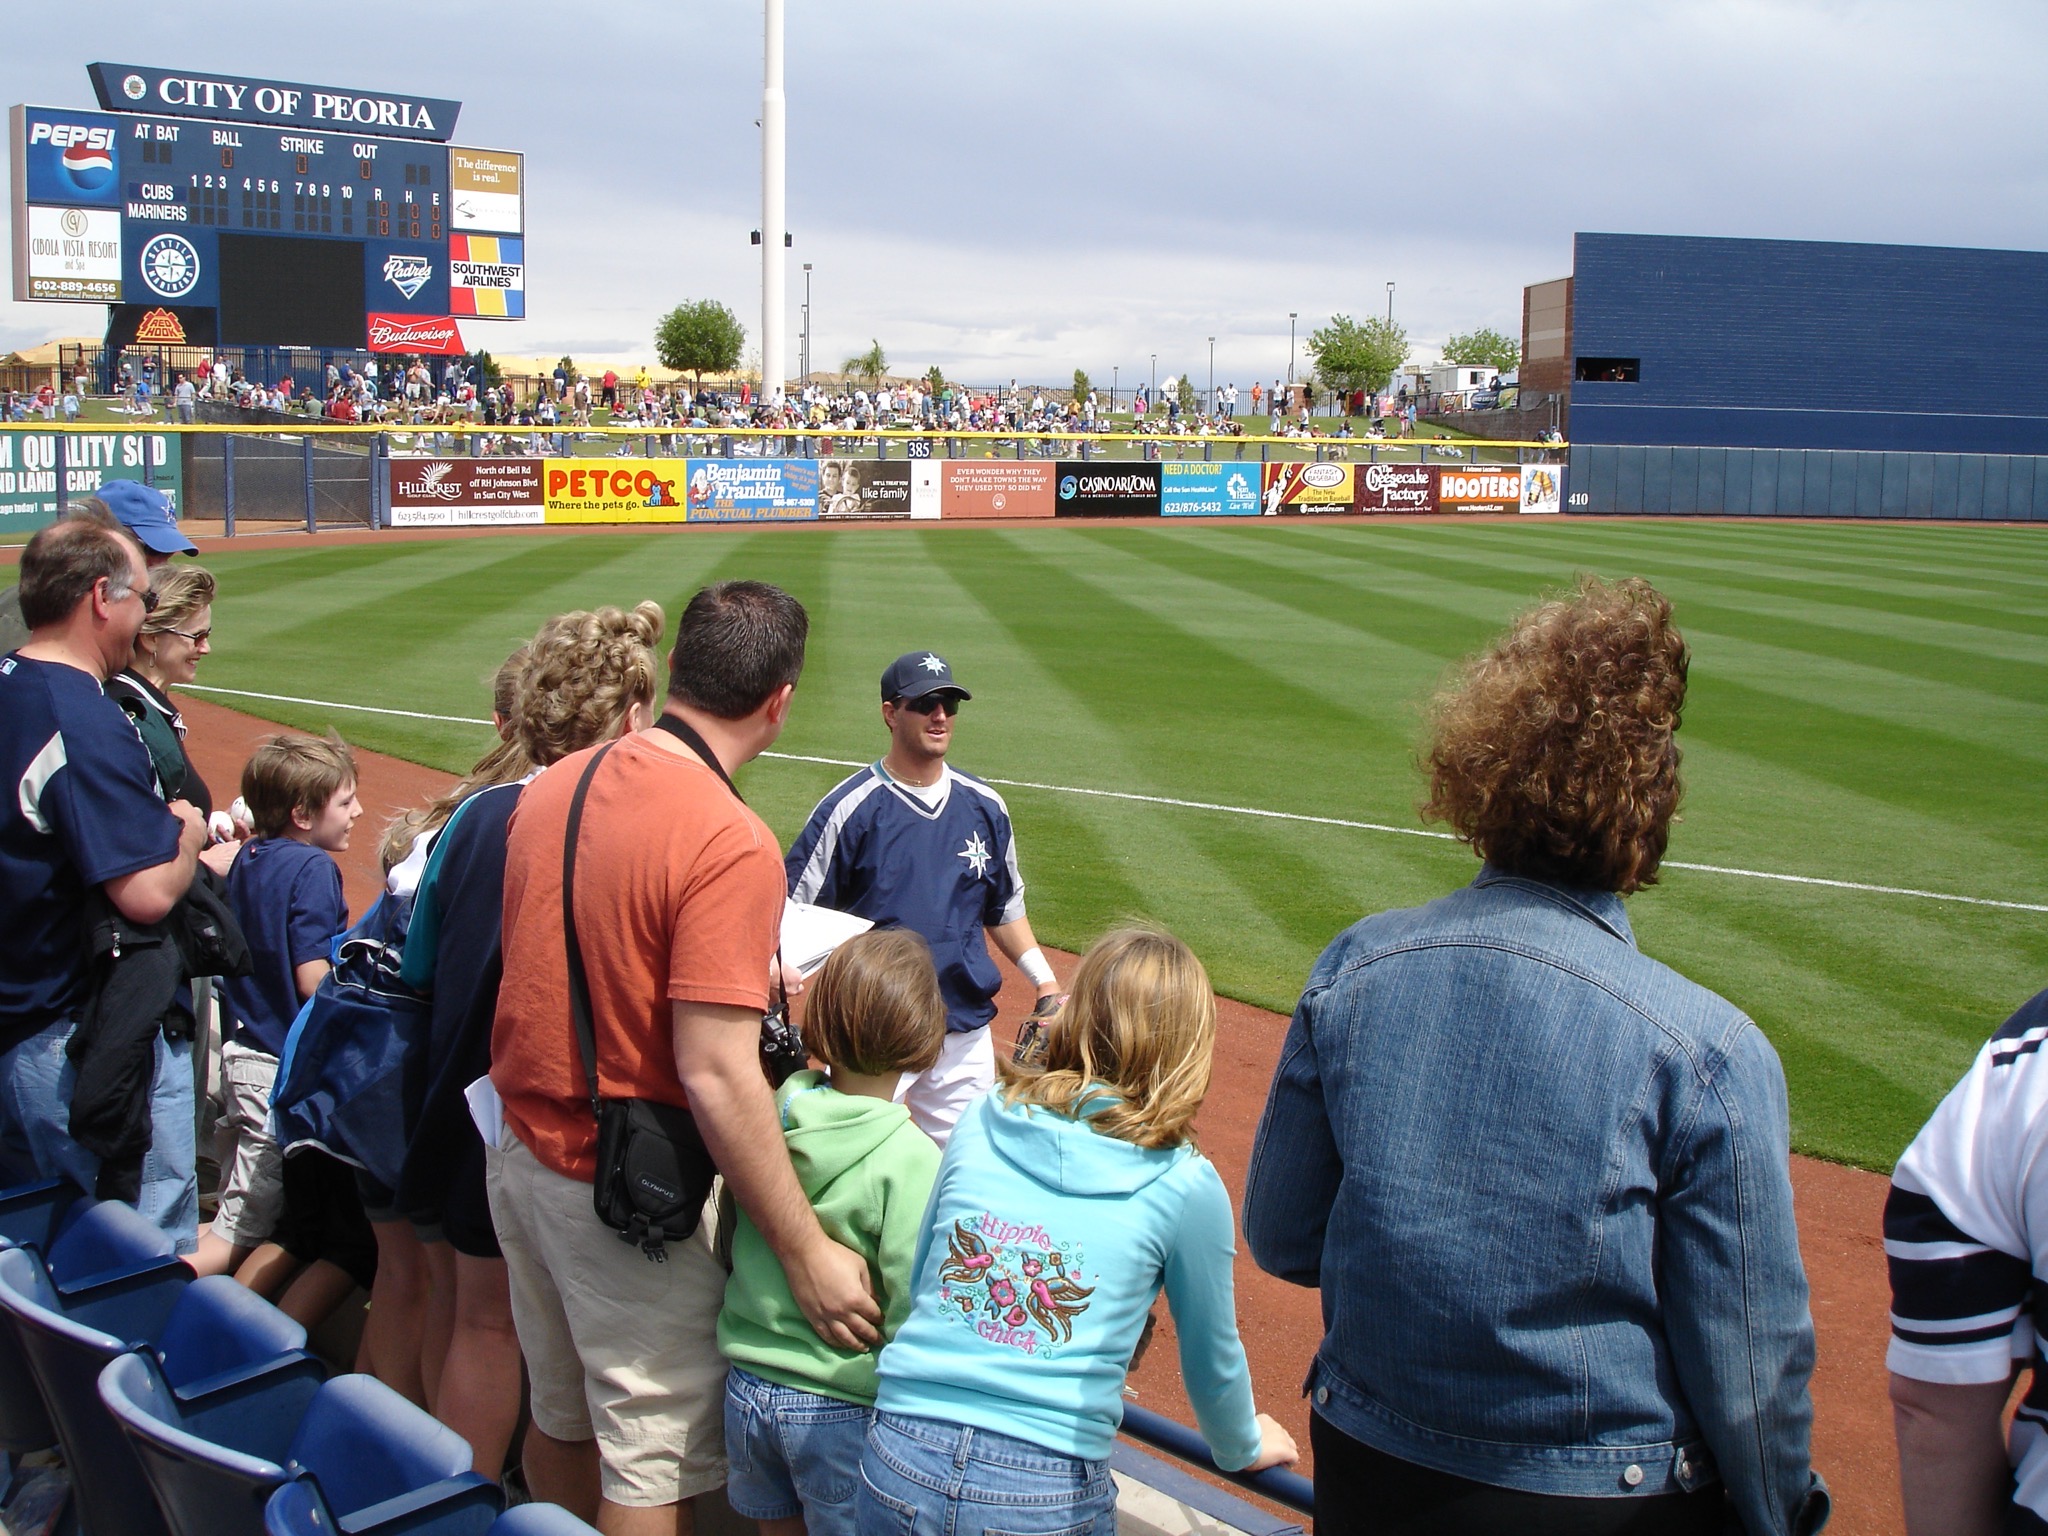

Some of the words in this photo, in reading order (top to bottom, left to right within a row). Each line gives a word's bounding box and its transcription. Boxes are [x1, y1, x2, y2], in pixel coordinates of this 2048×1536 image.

[159, 78, 248, 111] CITY
[255, 88, 301, 116] OF
[312, 93, 436, 130] PEORIA
[31, 123, 115, 150] PEPSI
[135, 123, 151, 139] AT
[156, 125, 180, 141] BAT
[212, 130, 242, 147] BALL
[281, 136, 324, 155] STRIKE
[353, 143, 378, 160] OUT
[456, 157, 473, 169] The
[475, 159, 517, 173] difference
[473, 171, 480, 181] is
[482, 173, 500, 183] real.
[142, 183, 174, 201] CUBS
[191, 174, 198, 187] 1
[204, 175, 213, 188] 2
[218, 176, 227, 189] 3
[243, 178, 251, 191] 4
[257, 179, 266, 193] 5
[271, 180, 279, 194] 6
[295, 182, 303, 195] 7
[308, 183, 317, 196] 8
[322, 184, 331, 198] 9
[341, 186, 353, 199] 10
[374, 188, 382, 201] R
[405, 190, 413, 204] H
[432, 193, 440, 206] E
[128, 203, 187, 221] MARINERS
[32, 238, 59, 256] CIBOLA
[63, 240, 85, 258] VISTA
[89, 241, 118, 260] RESORT
[148, 240, 192, 260] SEATTLE
[383, 260, 432, 281] Padres
[453, 263, 521, 278] SOUTHWEST
[148, 270, 193, 291] MARINERS
[463, 276, 511, 288] AIRLINES
[150, 319, 172, 327] RED
[145, 328, 176, 337] HOOK
[369, 326, 454, 344] Budweiser
[908, 442, 930, 458] 385
[476, 466, 497, 475] North
[498, 466, 506, 475] of
[507, 466, 520, 475] Bell
[521, 466, 531, 475] Rd
[706, 463, 781, 485] Benjamin
[1164, 464, 1182, 475] NEED
[1183, 464, 1189, 475] A
[1191, 464, 1222, 475] DOCTOR?
[1366, 465, 1429, 491] Cheesecake
[19, 470, 102, 494] LANDCAPE
[469, 479, 480, 487] off
[481, 479, 492, 487] RH
[493, 479, 522, 488] Johnson
[523, 479, 538, 487] Blvd
[549, 470, 657, 497] PETCO
[715, 481, 785, 499] Franklin
[1441, 476, 1519, 498] HOOTERS
[474, 491, 481, 499] in
[482, 491, 496, 499] Sun
[497, 490, 511, 500] City
[512, 490, 530, 499] West
[862, 487, 878, 499] like
[879, 487, 908, 501] family
[1568, 493, 1589, 506] 410
[548, 501, 581, 509] Where
[583, 501, 601, 509] the
[602, 501, 623, 511] pets
[626, 502, 640, 510] go.
[715, 499, 735, 508] THE
[1164, 502, 1221, 513] 623/876-5432
[458, 509, 538, 520] hillcrestgolfclub.com
[690, 508, 753, 519] PUNCTUAL
[755, 508, 811, 519] PLUMBER
[641, 1178, 674, 1199] OLYMPUS
[980, 1211, 1053, 1251] Hippie
